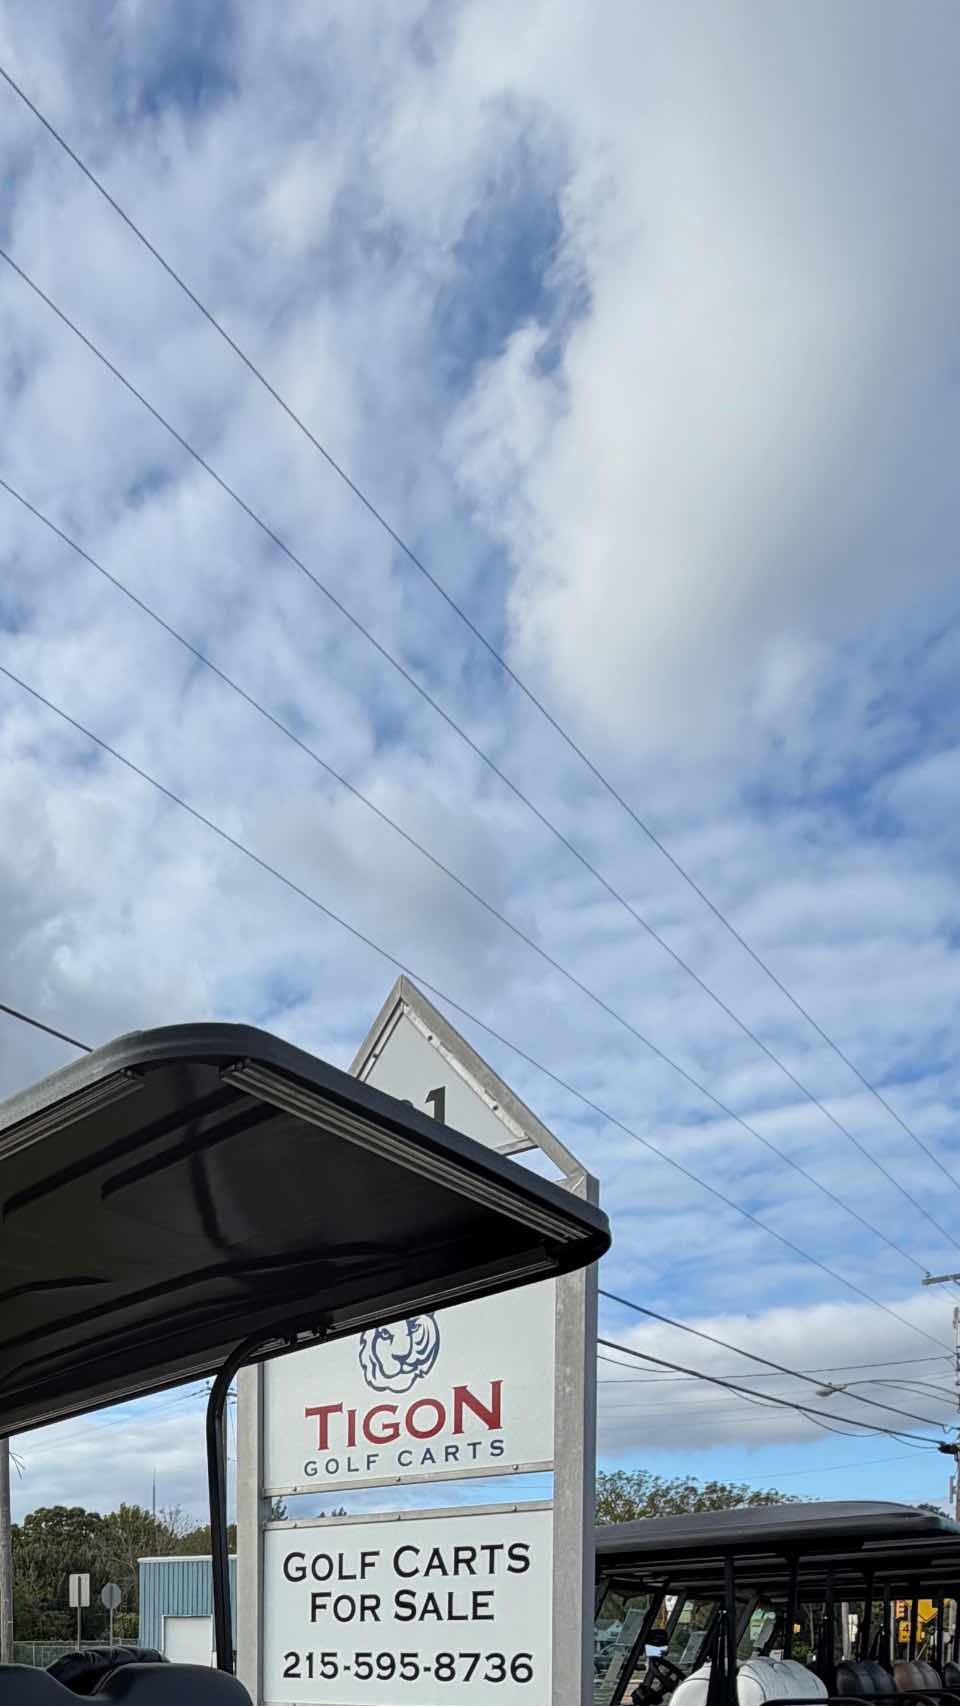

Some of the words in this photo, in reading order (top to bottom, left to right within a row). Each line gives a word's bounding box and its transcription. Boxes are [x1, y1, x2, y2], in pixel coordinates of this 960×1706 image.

[305, 1381, 502, 1451] TIGON
[304, 1454, 380, 1477] GOLF
[397, 1439, 504, 1467] CARTS
[283, 1551, 380, 1583] GOLF
[393, 1542, 531, 1578] CARTS
[310, 1592, 381, 1623] FOR
[394, 1590, 494, 1622] SALE
[283, 1651, 533, 1684] 215-595-8736
